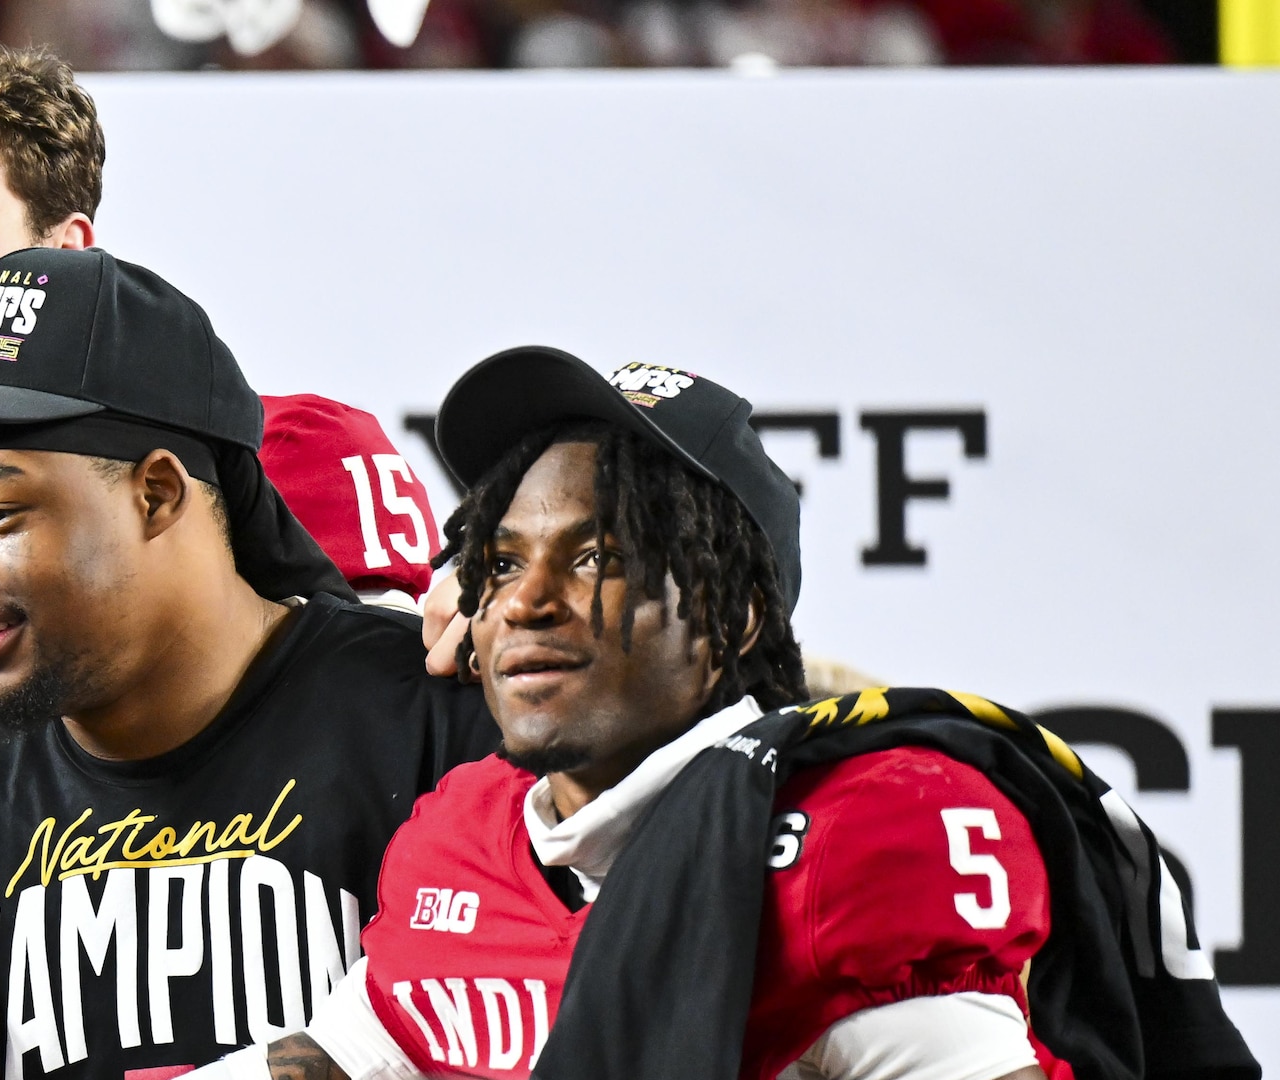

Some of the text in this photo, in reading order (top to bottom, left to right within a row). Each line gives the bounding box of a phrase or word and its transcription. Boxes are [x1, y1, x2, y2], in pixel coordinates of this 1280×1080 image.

[340, 453, 431, 570] 15
[4, 778, 303, 898] National
[940, 807, 1012, 930] 5
